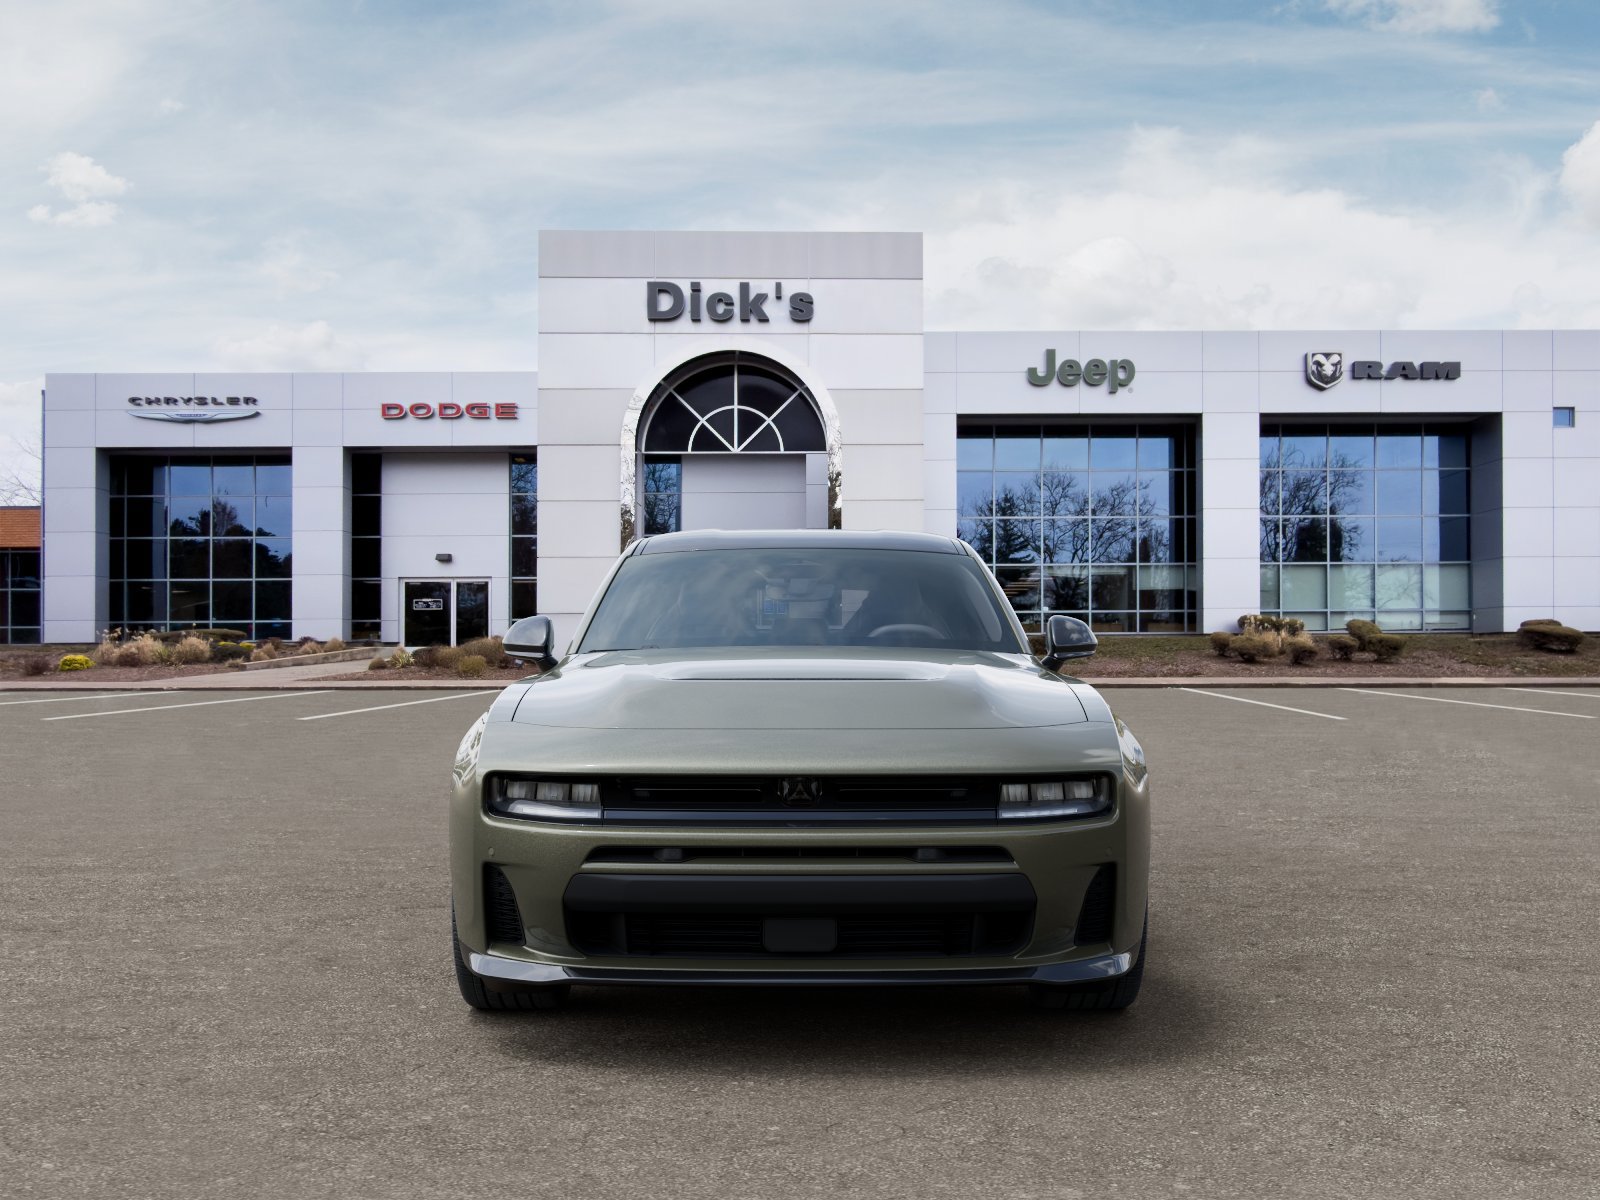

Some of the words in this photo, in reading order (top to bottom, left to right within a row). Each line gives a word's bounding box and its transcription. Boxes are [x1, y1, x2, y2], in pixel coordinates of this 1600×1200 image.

[647, 282, 814, 322] Dick's
[1027, 349, 1135, 394] Jeep
[1352, 361, 1461, 380] RAM
[128, 396, 258, 406] CHRYSLER
[381, 403, 518, 419] DODGE
